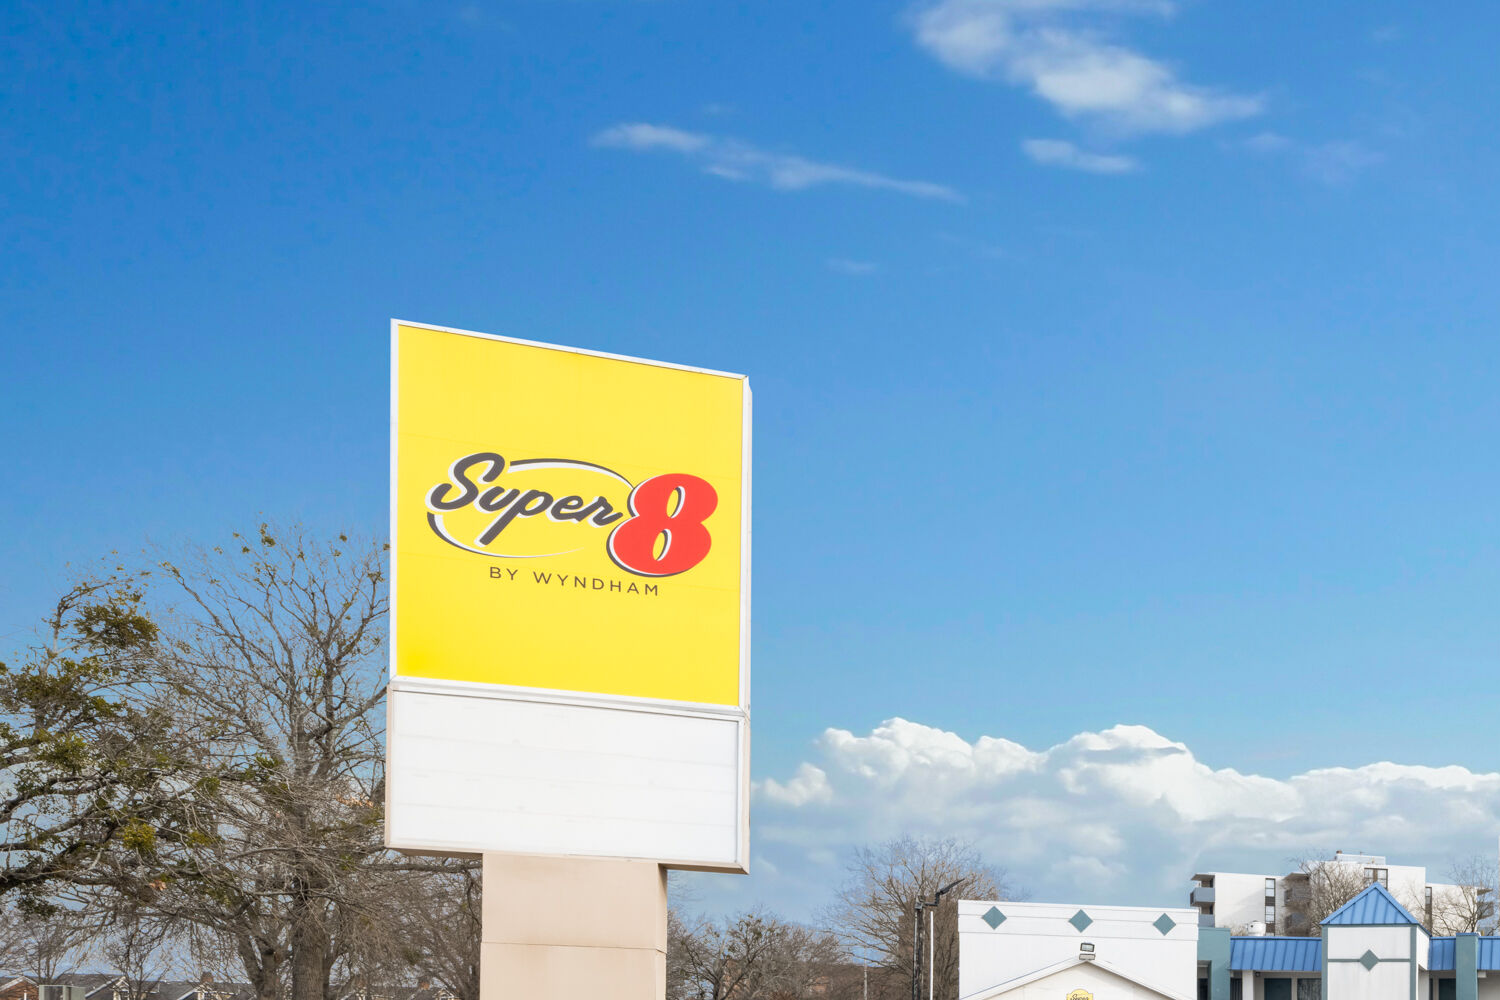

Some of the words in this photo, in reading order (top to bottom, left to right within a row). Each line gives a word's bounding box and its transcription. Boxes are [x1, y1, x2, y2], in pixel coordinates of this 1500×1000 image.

[427, 451, 624, 546] Super
[607, 473, 719, 578] 8
[489, 566, 518, 581] BY
[533, 571, 658, 596] WYNDHAM
